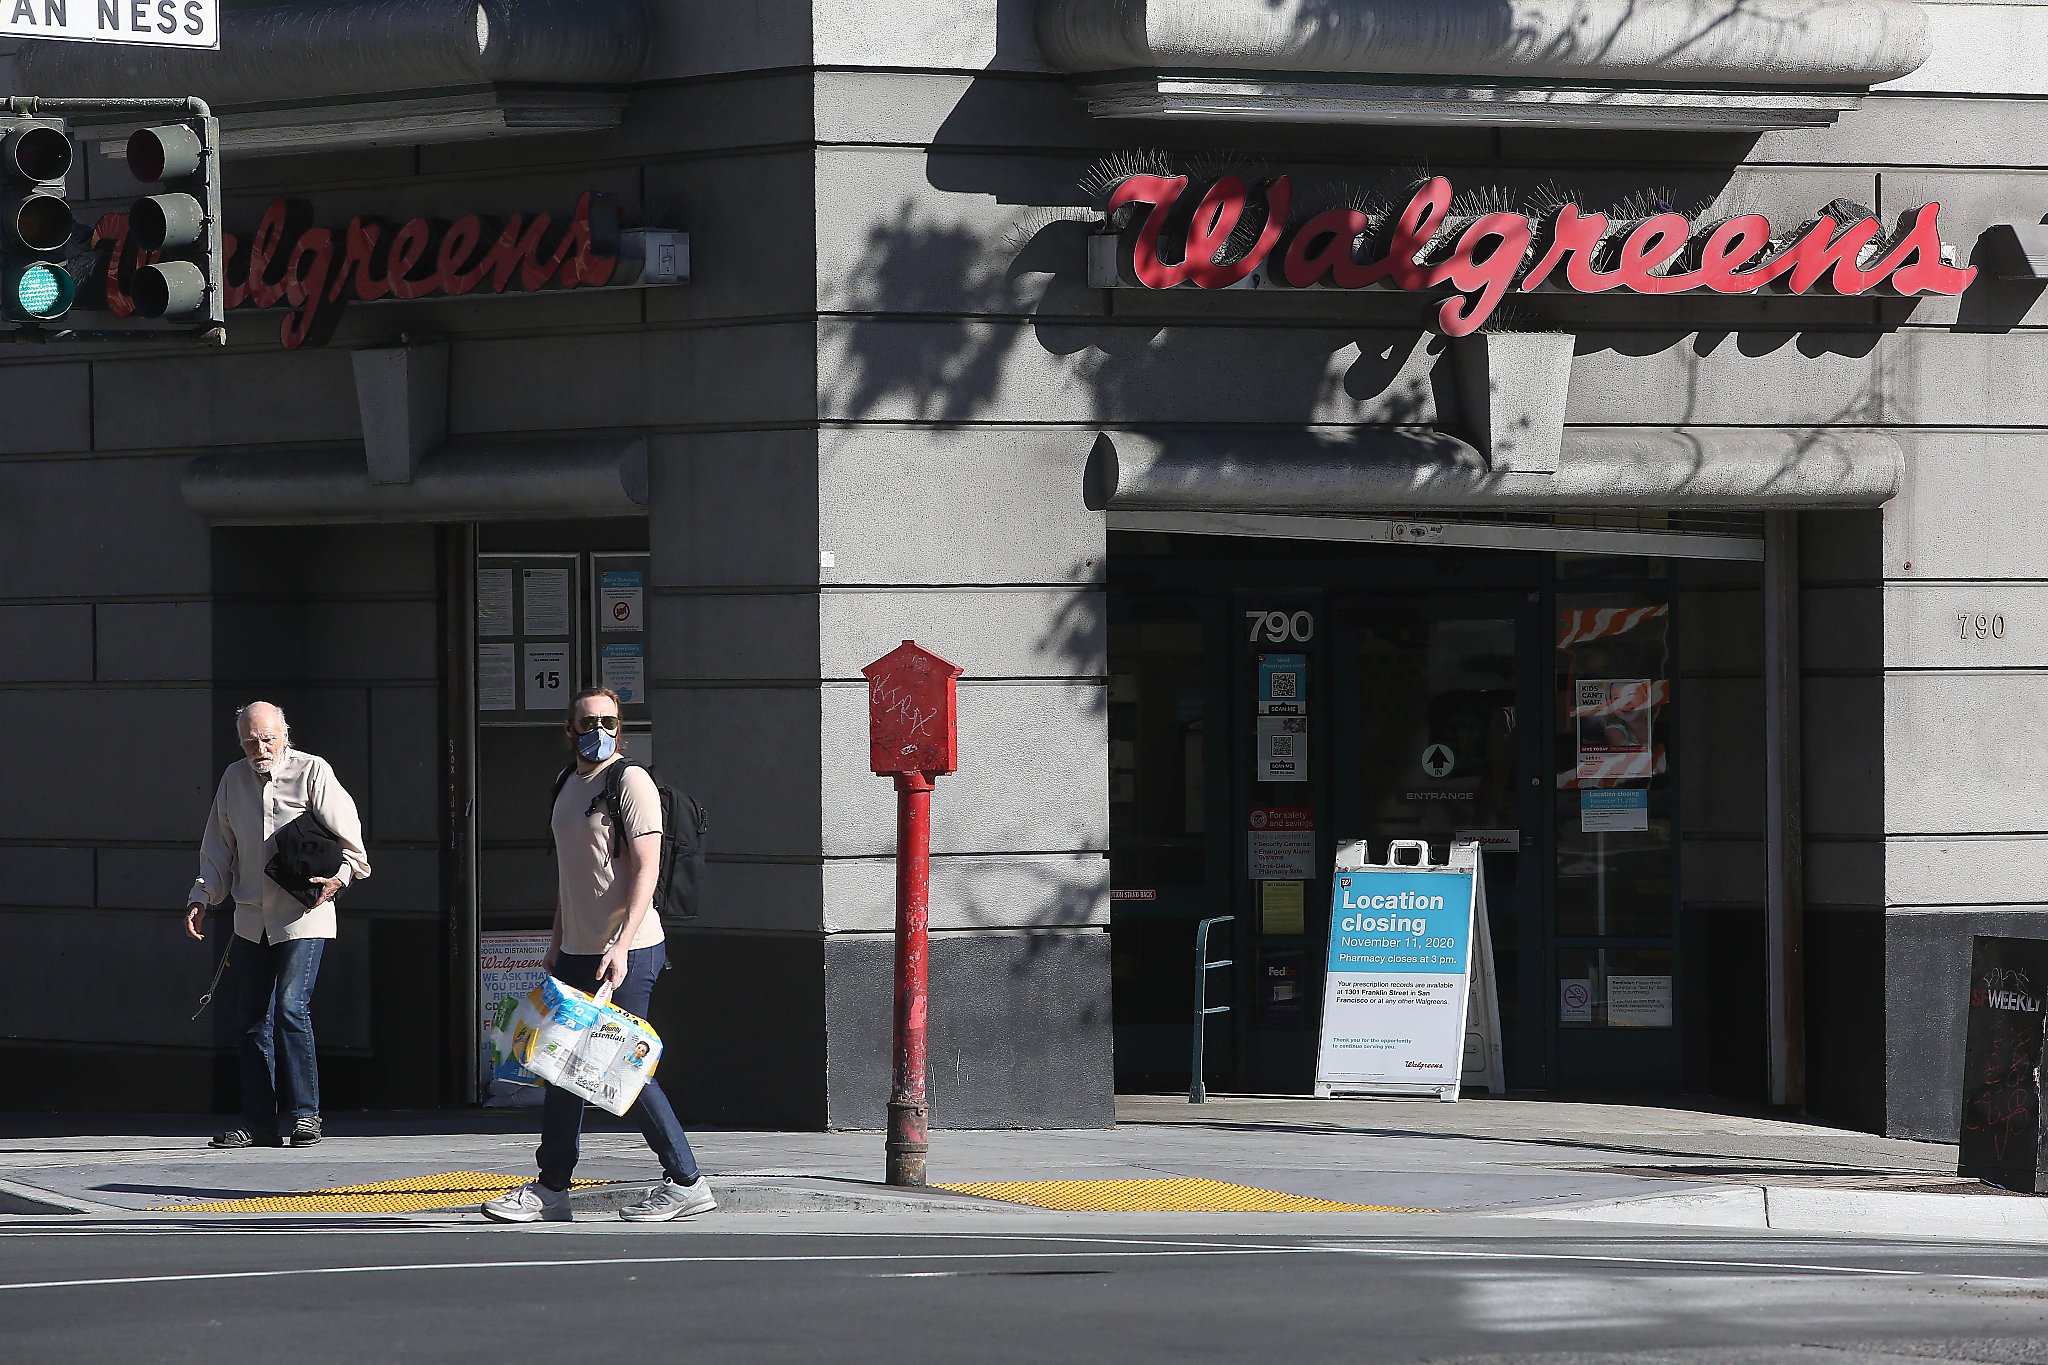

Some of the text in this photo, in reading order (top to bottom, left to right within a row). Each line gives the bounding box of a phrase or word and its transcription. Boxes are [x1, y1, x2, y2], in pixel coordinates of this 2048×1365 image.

[0, 0, 204, 36] AN NESS
[1108, 174, 1978, 337] Walgreens
[1245, 611, 1314, 642] 790
[1957, 613, 2005, 639] 790
[535, 672, 560, 689] 15
[1434, 768, 1443, 776] IN
[1406, 792, 1474, 800] ENTRANCE
[1269, 811, 1307, 820] For safety
[1285, 820, 1314, 828] savings
[1463, 835, 1511, 846] Walgreens
[1342, 890, 1444, 910] Location
[1341, 914, 1427, 937] closing
[1341, 936, 1455, 950] November 11, 2020
[504, 946, 545, 954] DISTANCING
[480, 955, 543, 974] Walgreen
[1339, 954, 1457, 965] Pharmacy closes at 3 pm.
[482, 972, 549, 982] WE ASK THAT
[484, 982, 541, 992] YOU PLEAS
[1338, 980, 1351, 988] Your
[1336, 996, 1369, 1004] Francisco
[1415, 998, 1450, 1006] Walgreens.
[590, 1032, 626, 1043] Essentials
[1404, 1060, 1444, 1070] Walgreens
